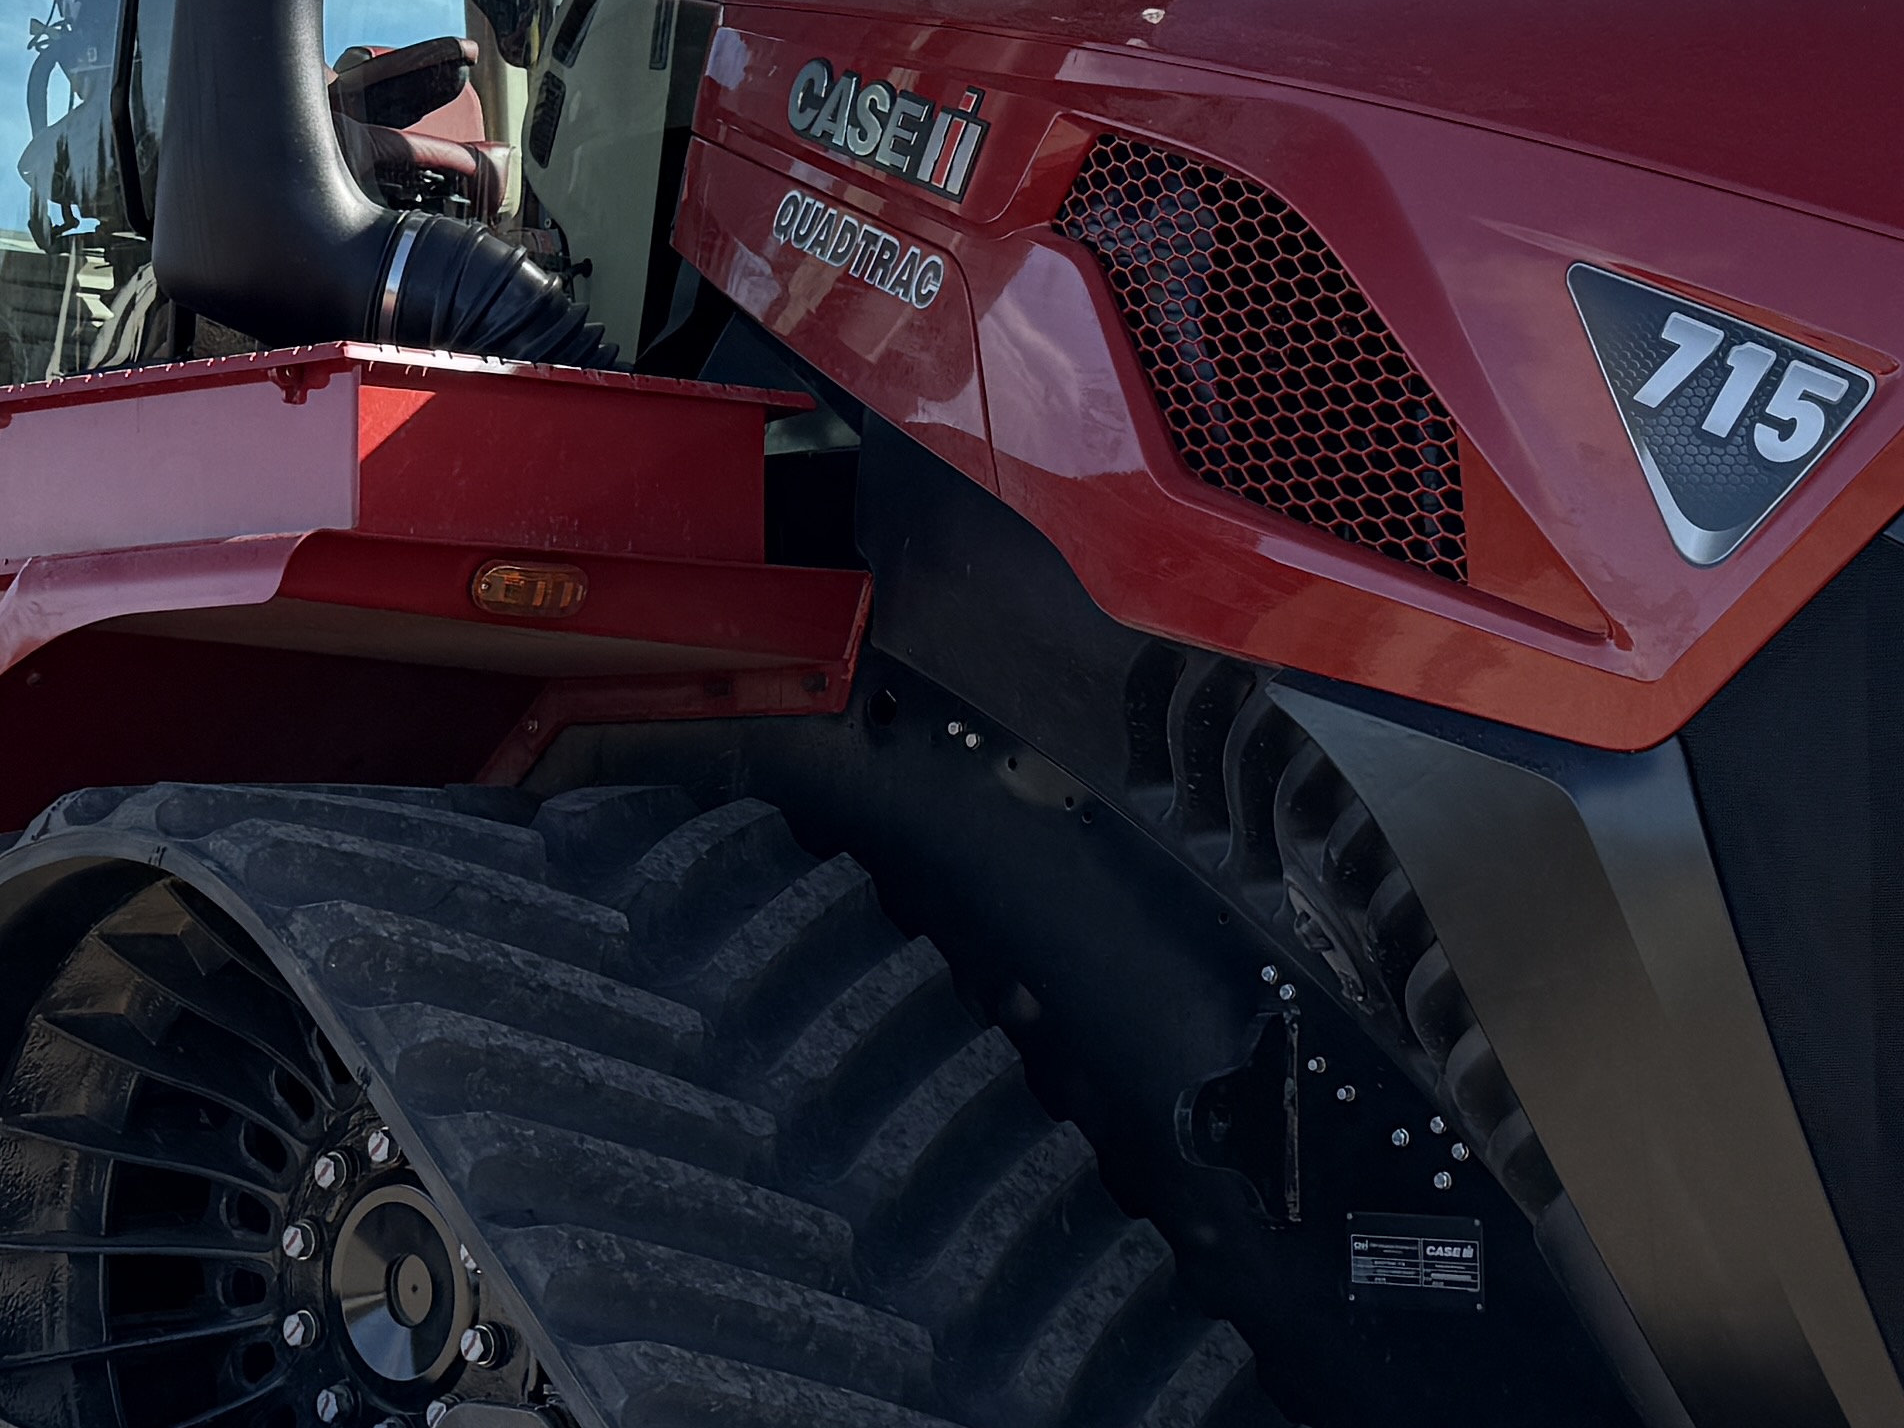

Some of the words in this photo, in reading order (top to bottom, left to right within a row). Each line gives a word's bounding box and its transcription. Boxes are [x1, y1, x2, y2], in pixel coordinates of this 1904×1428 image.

[788, 57, 933, 174] CASE
[773, 190, 944, 309] QUADTRAC
[1633, 311, 1849, 463] 715
[1426, 1245, 1460, 1258] CASE
